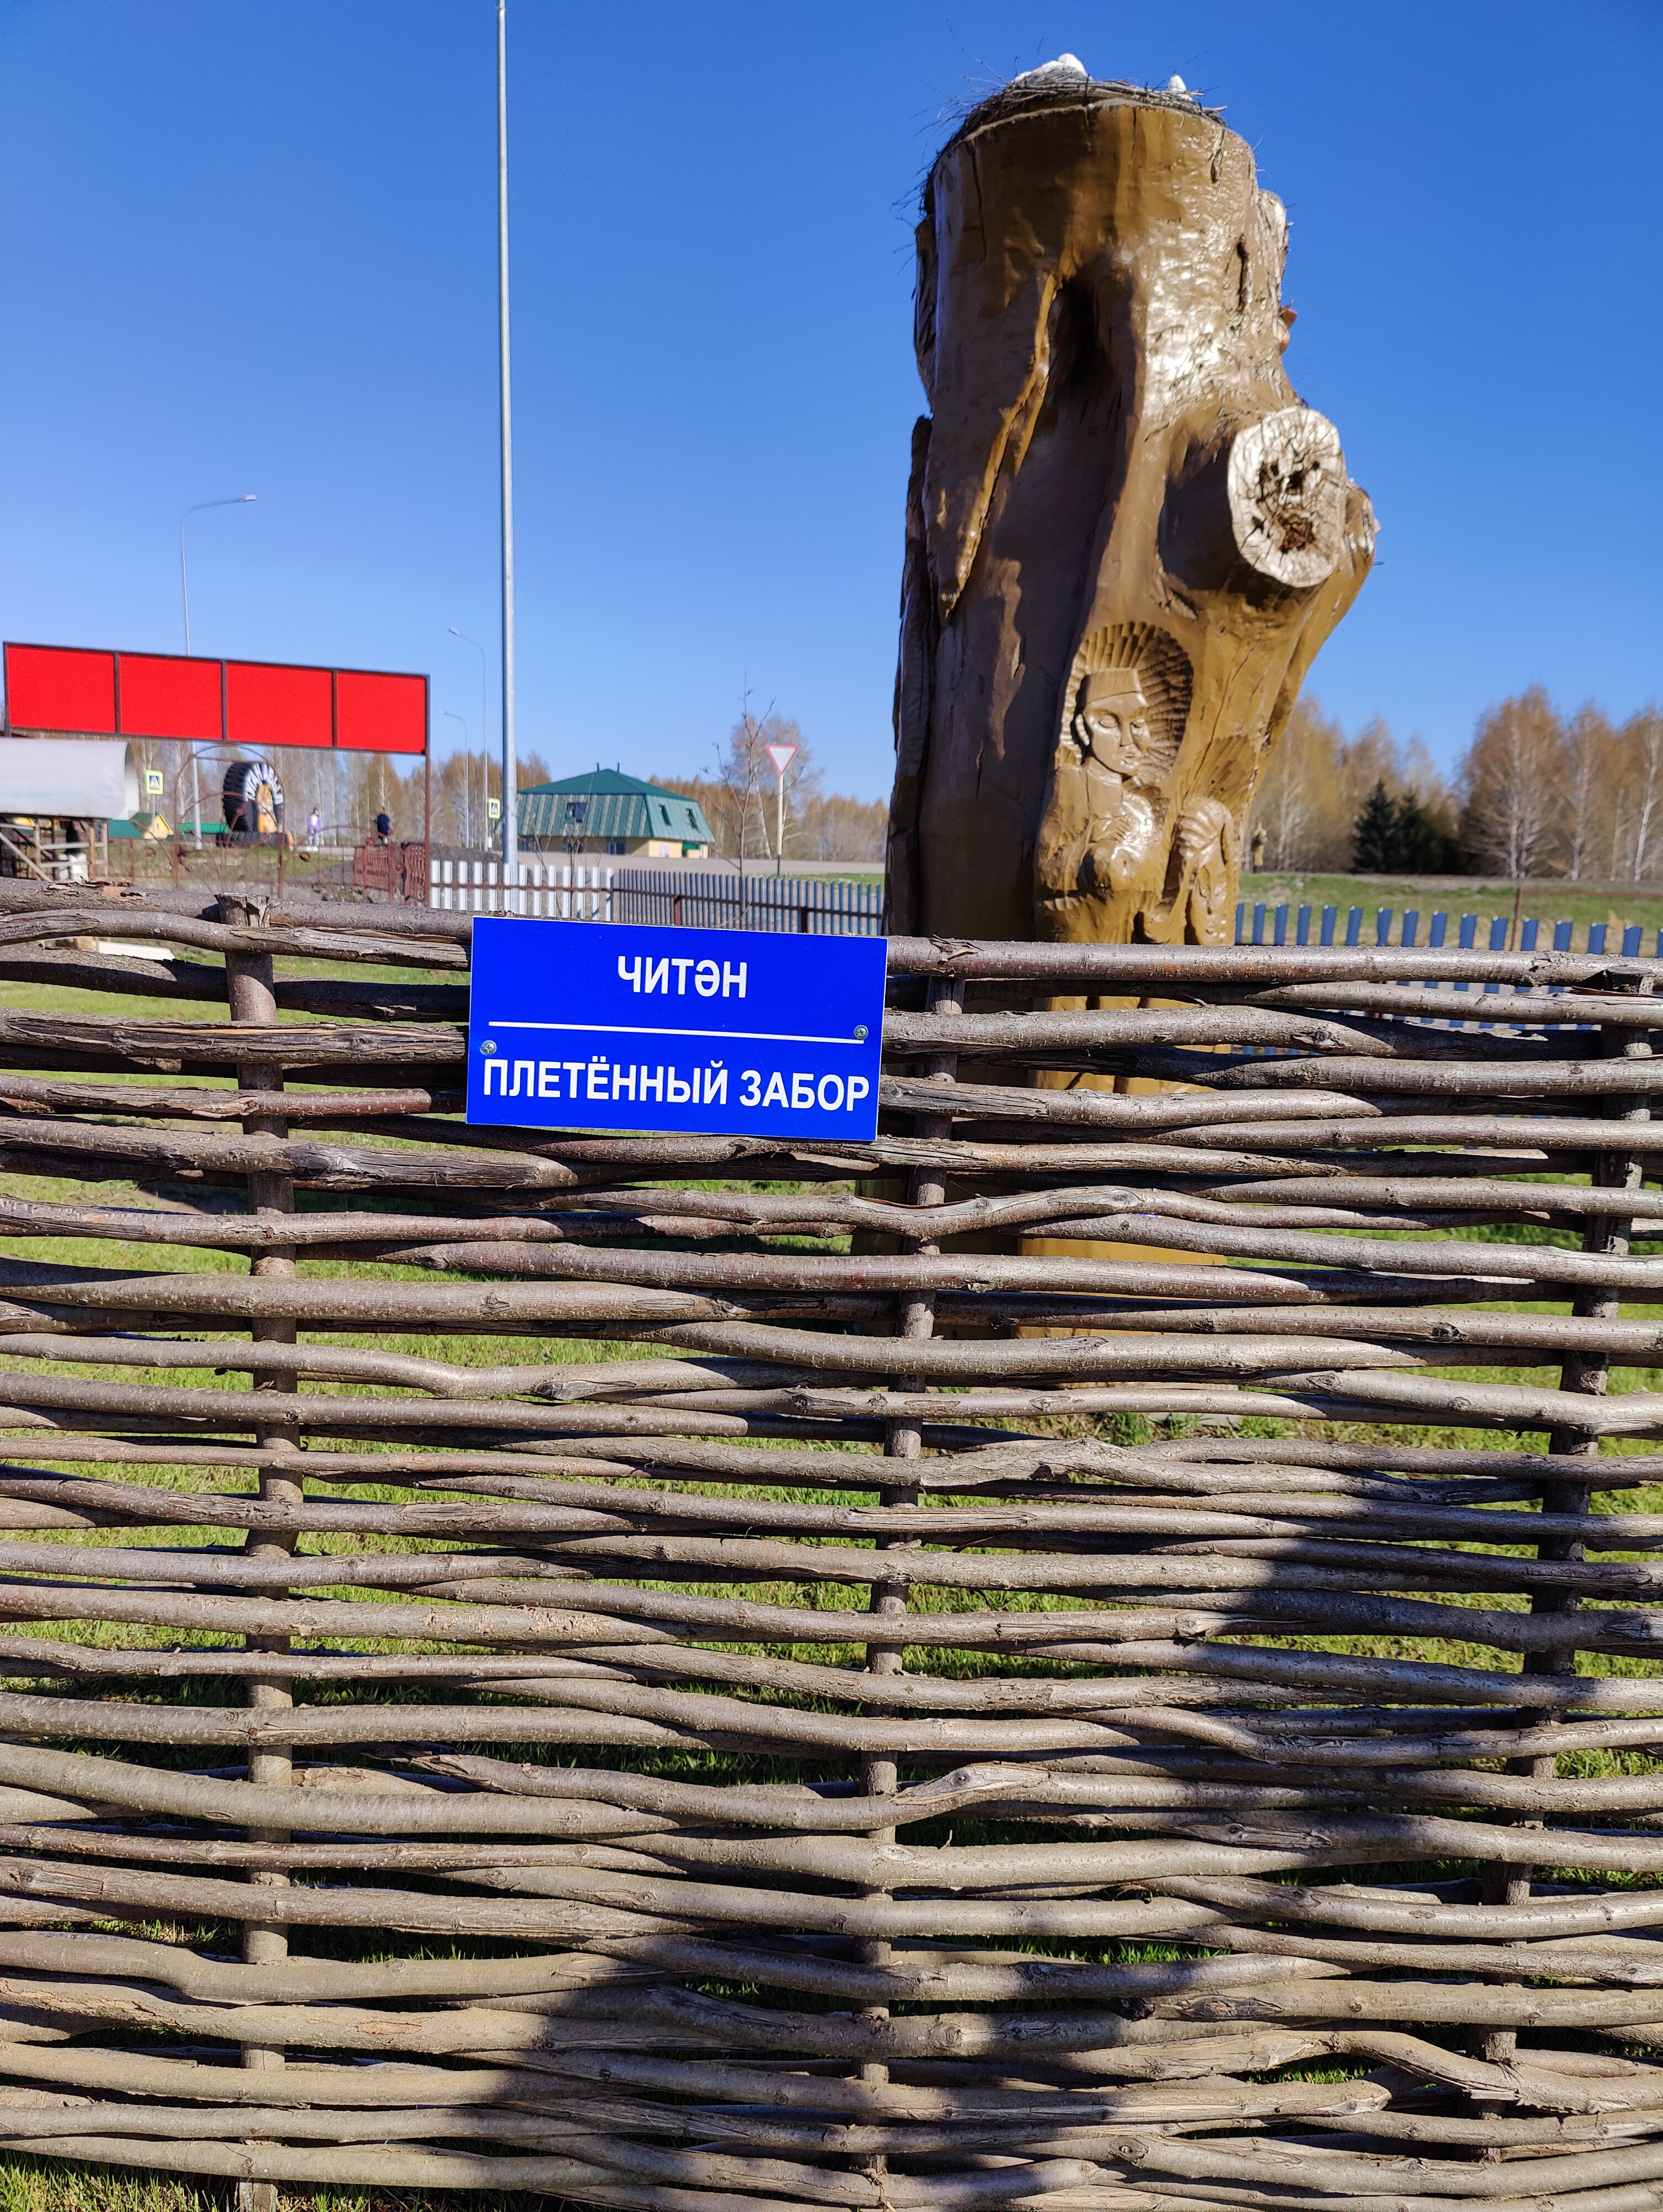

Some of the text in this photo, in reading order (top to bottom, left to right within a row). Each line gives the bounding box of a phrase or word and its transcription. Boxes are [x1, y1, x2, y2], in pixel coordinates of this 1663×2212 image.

[618, 956, 747, 998] ЧИТӘН
[484, 1056, 869, 1112] ПЛЕТЁННЫЙ ЗАБОР
